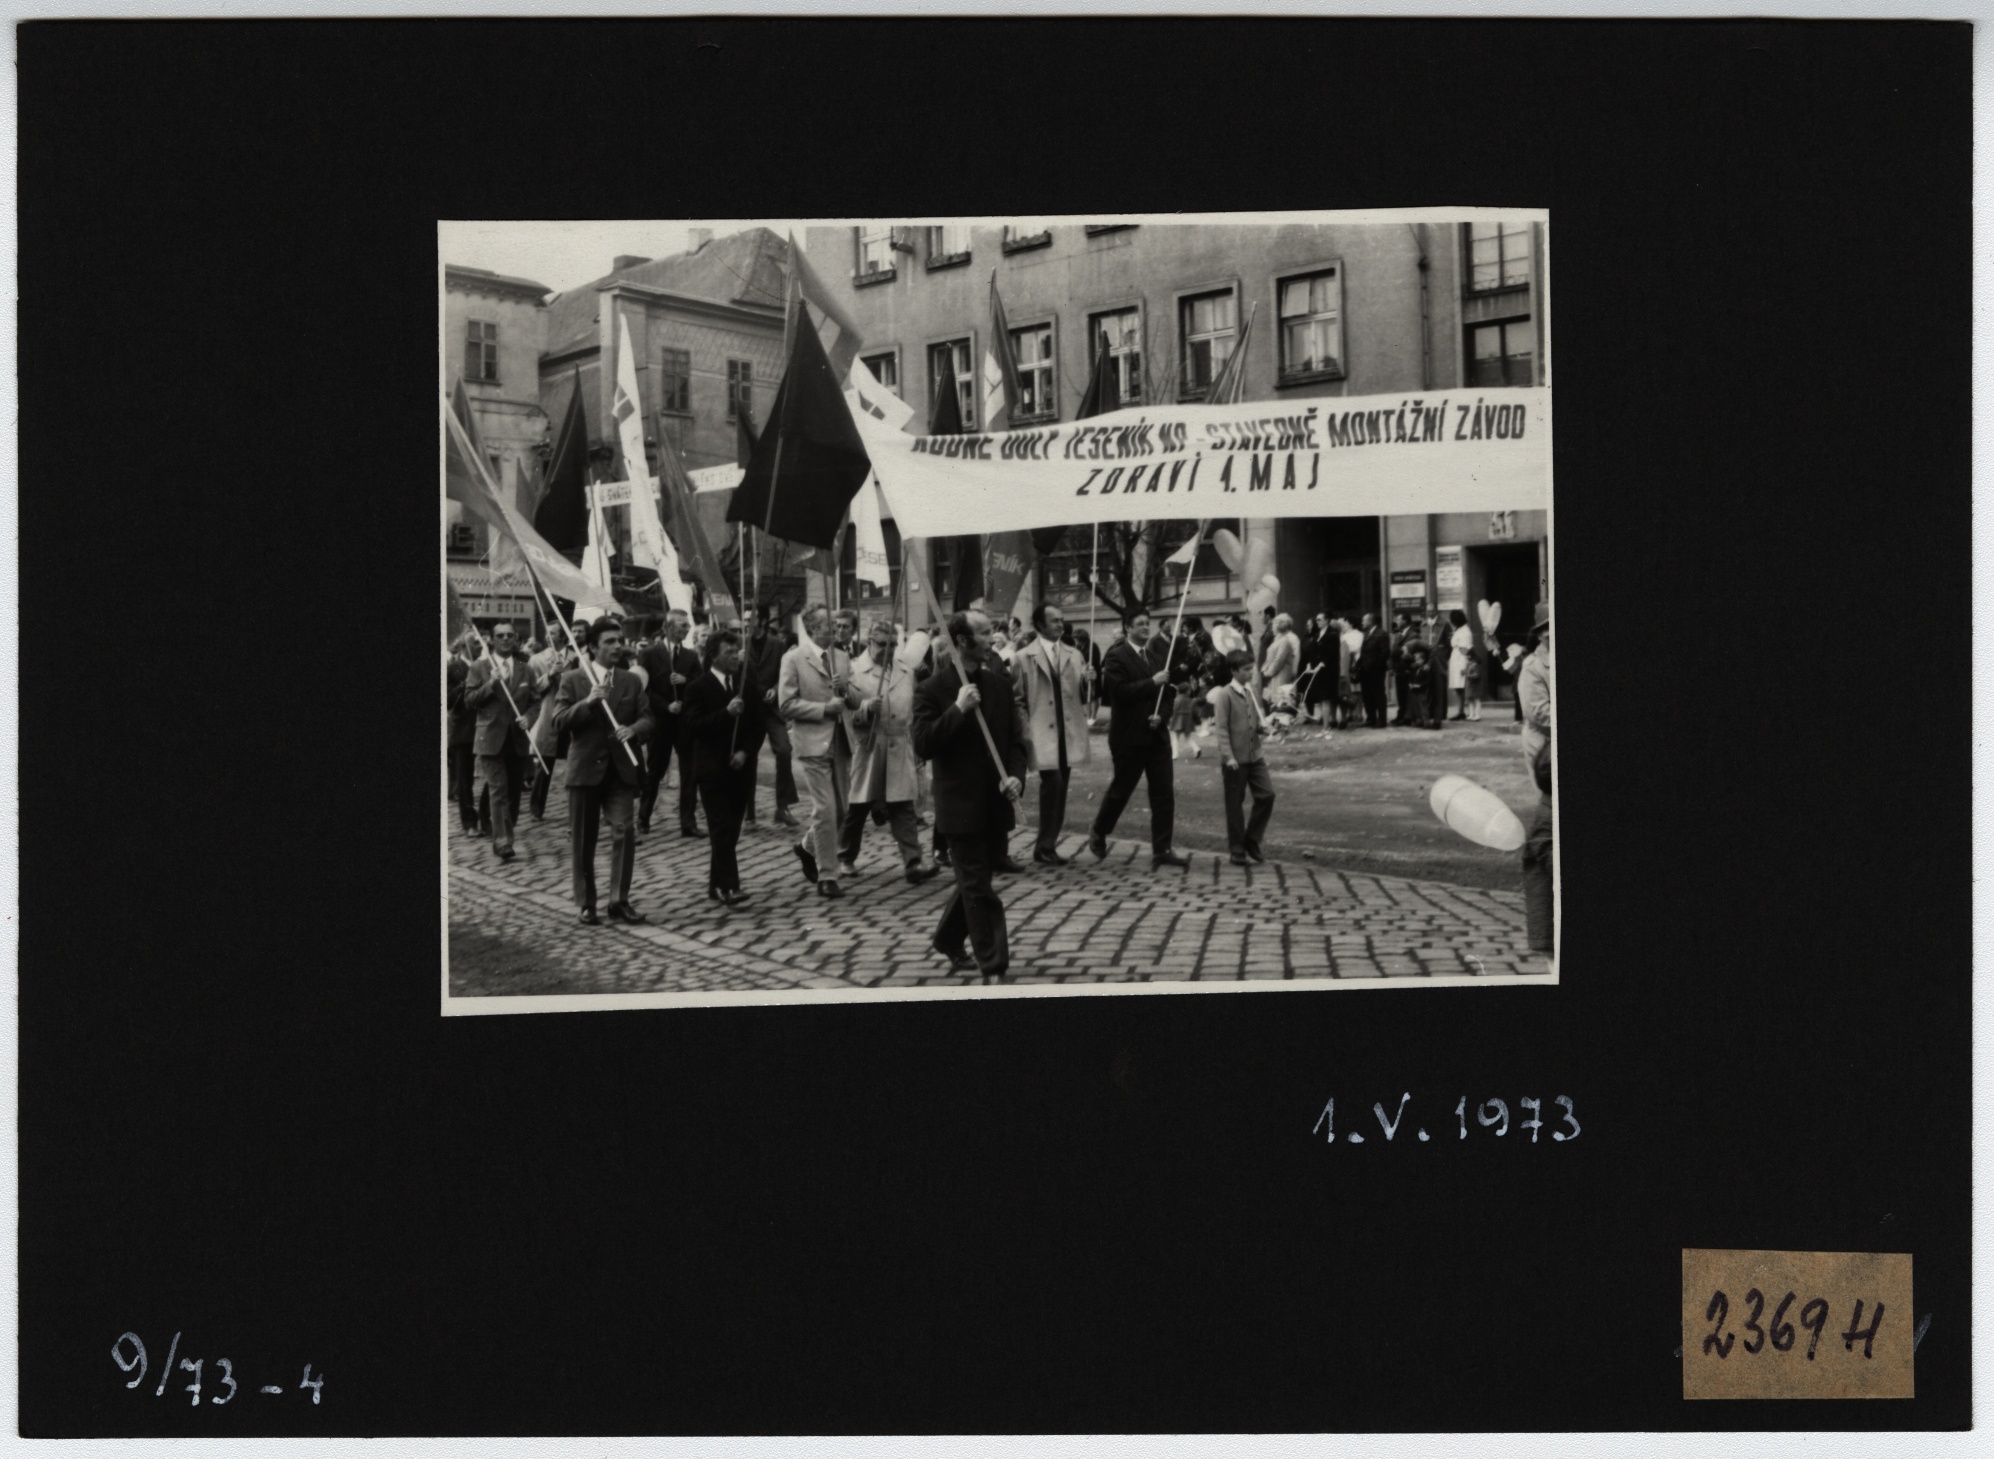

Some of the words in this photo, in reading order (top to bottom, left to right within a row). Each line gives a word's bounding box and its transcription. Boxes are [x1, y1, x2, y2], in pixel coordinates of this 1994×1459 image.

[1064, 416, 1155, 460] JESENÍK
[1205, 407, 1320, 450] STAVEBNĚ
[1328, 398, 1449, 448] MONTÁŽNÍ
[1454, 398, 1527, 441] ZÁVOD
[1076, 451, 1202, 496] ZDRAVÍ
[1220, 454, 1237, 493] 1.
